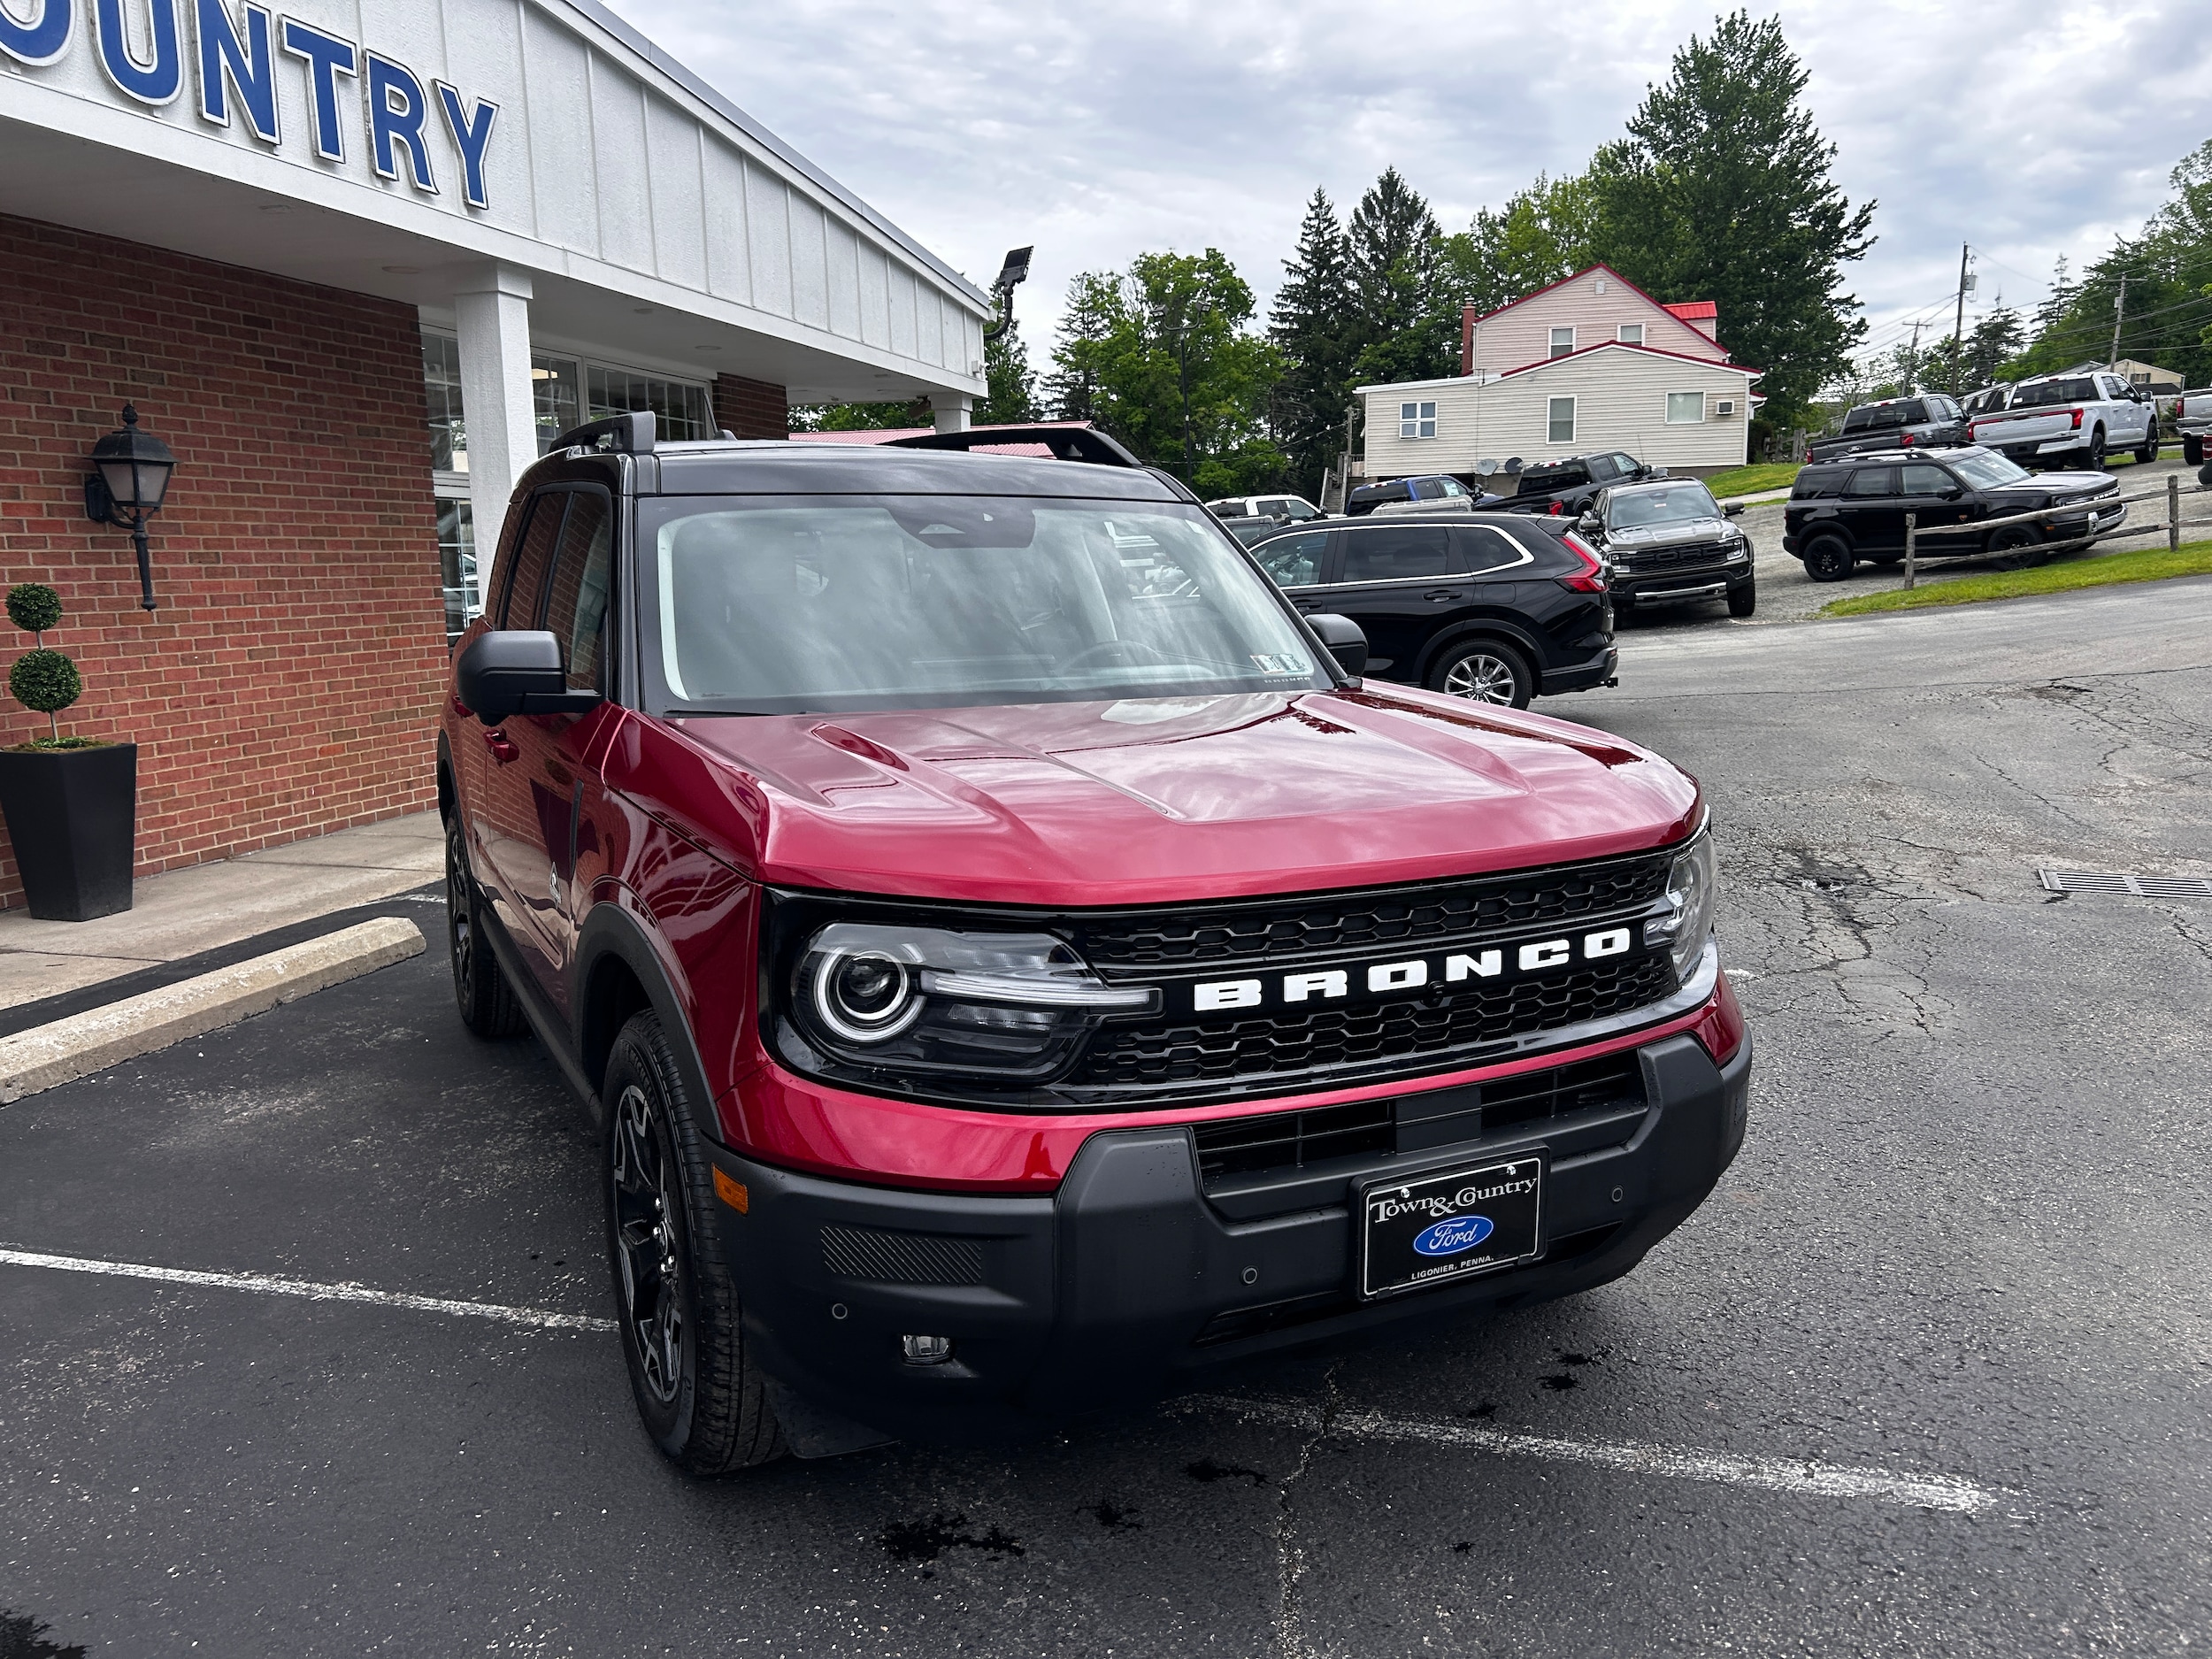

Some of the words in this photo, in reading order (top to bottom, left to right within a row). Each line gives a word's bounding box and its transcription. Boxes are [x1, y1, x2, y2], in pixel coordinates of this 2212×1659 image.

[1194, 927, 1630, 1011] BRONCO
[1429, 1221, 1479, 1250] Ford
[1461, 1255, 1494, 1269] PENNA.
